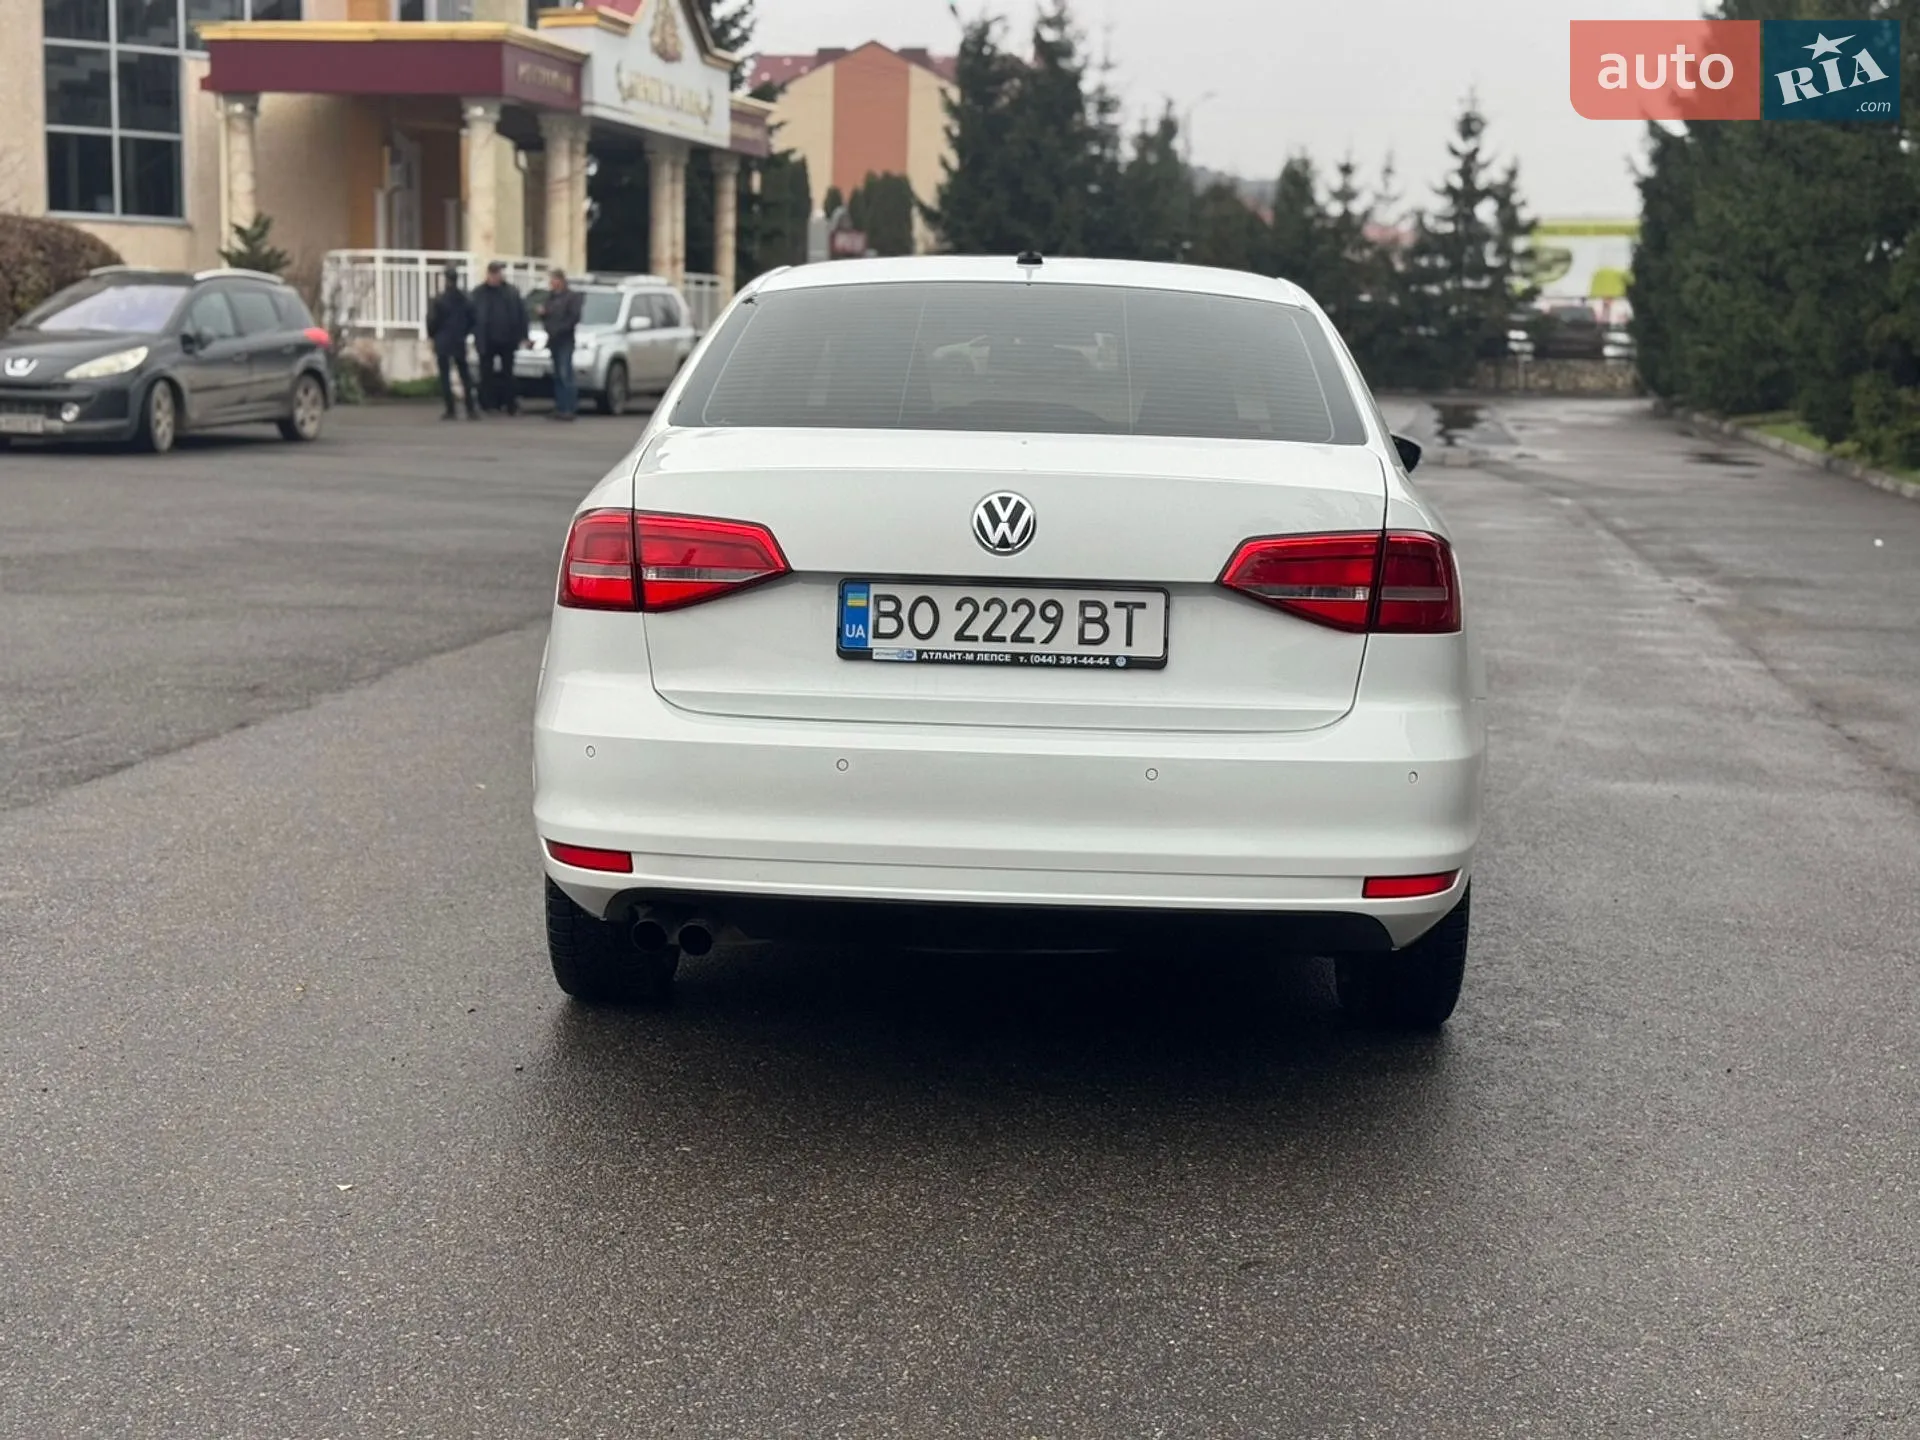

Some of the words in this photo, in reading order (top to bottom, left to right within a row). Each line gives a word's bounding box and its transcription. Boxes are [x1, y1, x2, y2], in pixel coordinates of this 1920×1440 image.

[872, 594, 940, 641] BO
[954, 597, 1064, 644] 2229
[1078, 599, 1147, 648] BT
[845, 624, 866, 639] UA
[921, 651, 974, 662] АТЛАНТ-М
[976, 652, 1011, 663] ЛЕПСЕ
[1030, 655, 1056, 665] (044)
[1059, 656, 1110, 666] 391-44-44
